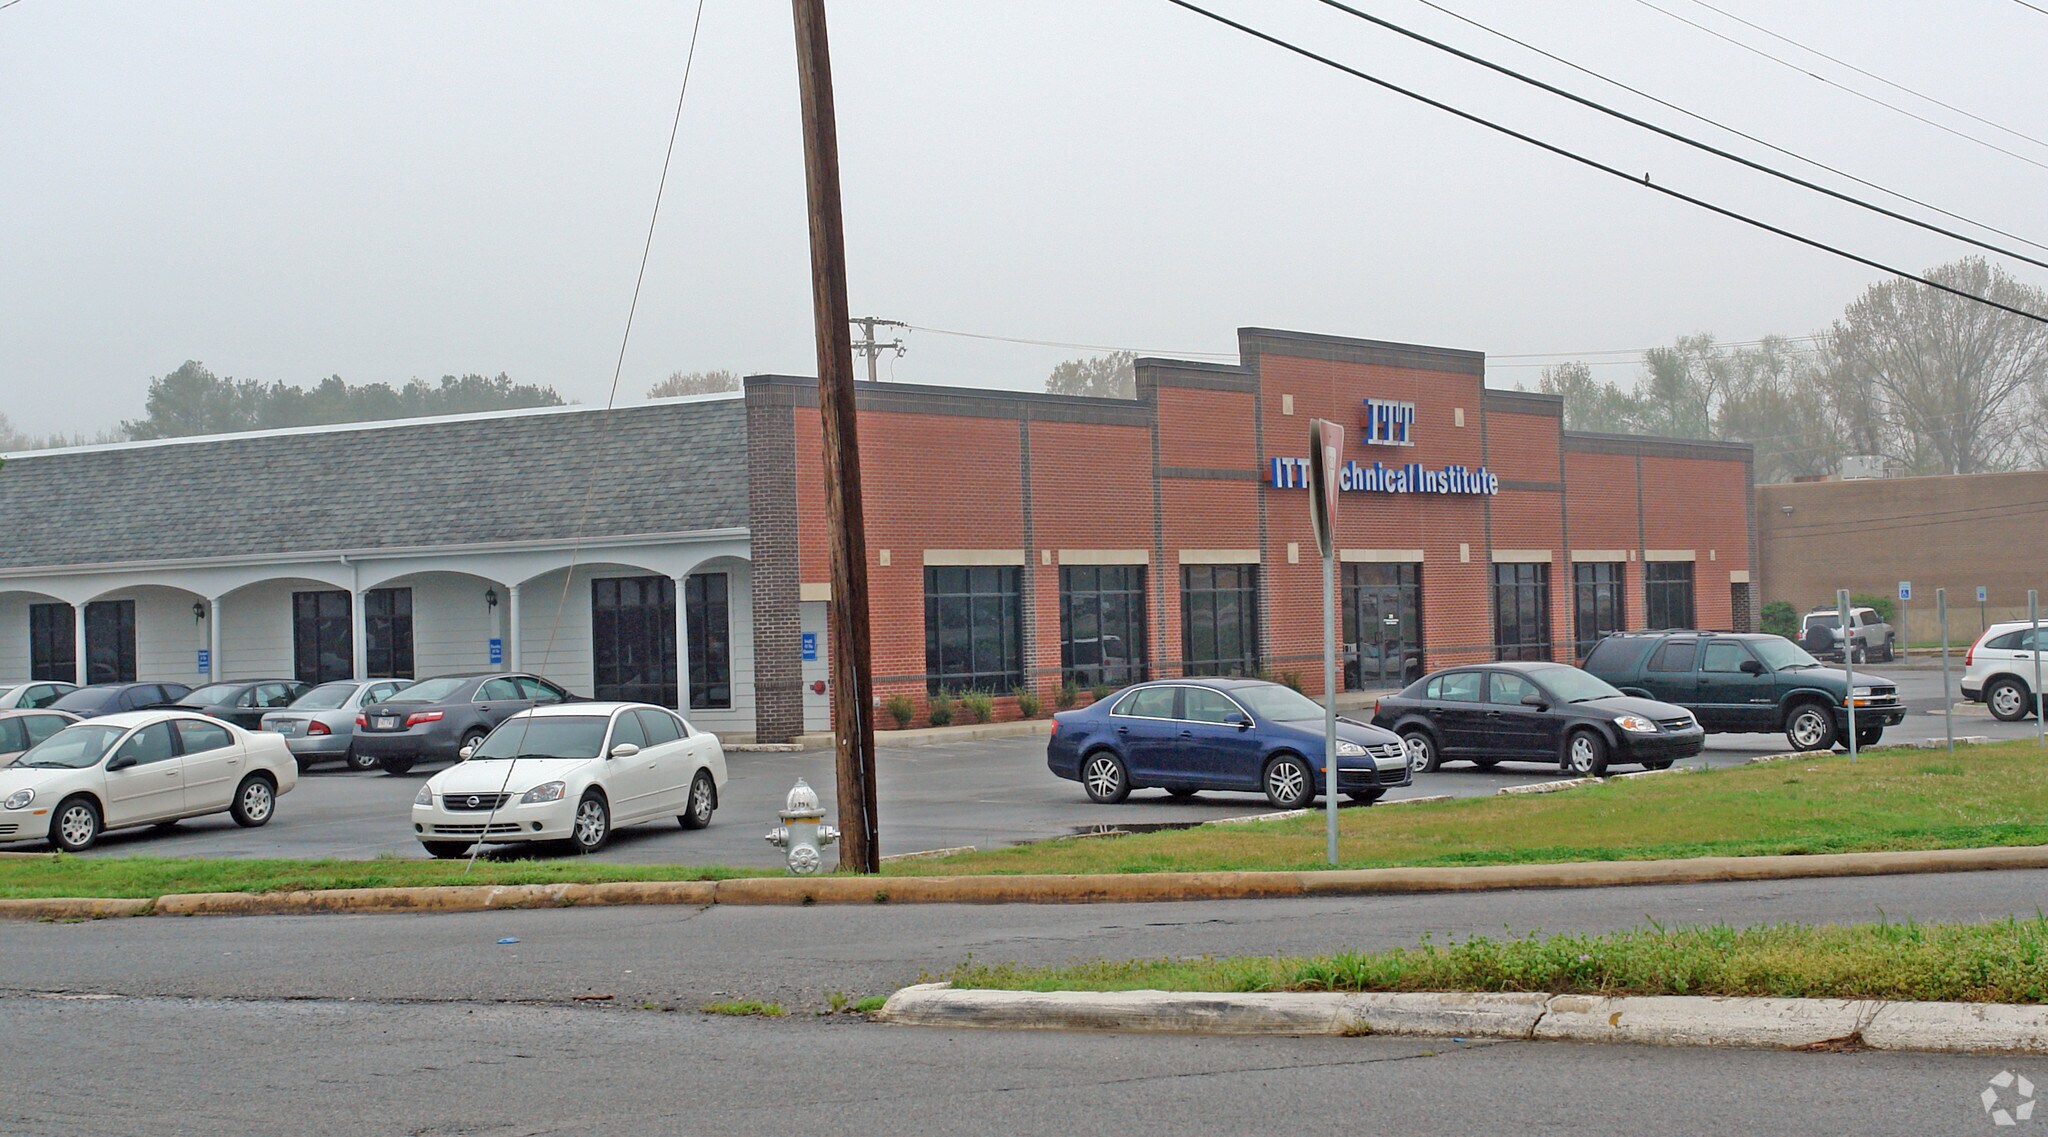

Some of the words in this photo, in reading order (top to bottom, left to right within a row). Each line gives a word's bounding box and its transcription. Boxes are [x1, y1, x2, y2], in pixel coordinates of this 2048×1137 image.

[1363, 399, 1415, 446] ITT
[1338, 460, 1414, 493] chnical
[1414, 463, 1498, 496] Institute
